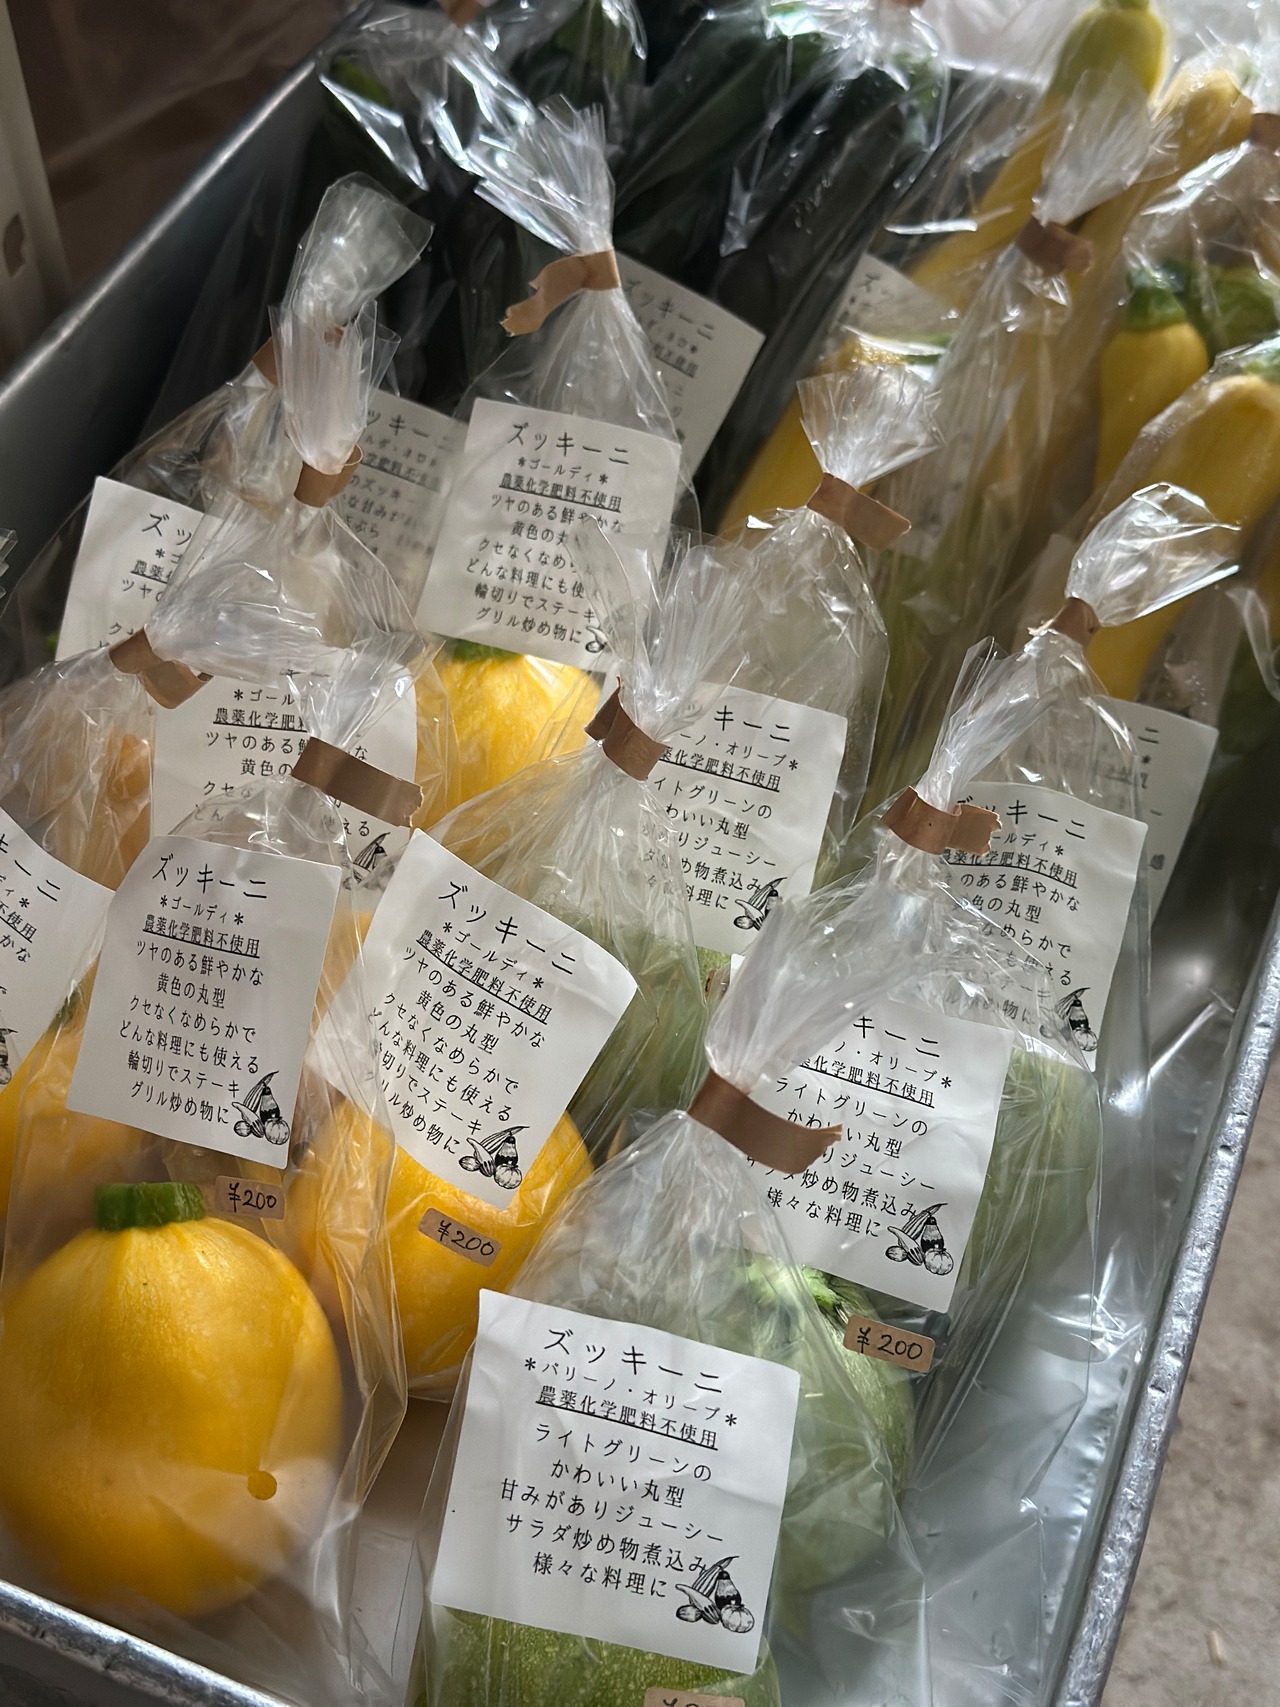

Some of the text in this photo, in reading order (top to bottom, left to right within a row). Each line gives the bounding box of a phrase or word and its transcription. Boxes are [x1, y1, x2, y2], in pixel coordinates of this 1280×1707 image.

[507, 422, 630, 465] ズッキーニ
[500, 473, 623, 512] 農薬化学肥料不使用
[475, 582, 597, 623] 輪切りでステーキ
[476, 606, 582, 643] グリル炒め物に
[152, 853, 267, 899] ズッキーニ
[143, 914, 260, 958] 農薬化学肥料不使用
[438, 881, 577, 975] ズッキーニ
[137, 940, 264, 986] ツヤのある鮮やかな
[416, 929, 553, 1025] 農薬化学肥料不使用
[156, 972, 227, 1009] 黄色の丸型
[402, 946, 547, 1049] ツヤのある鮮やかな
[130, 994, 256, 1044] クセなくなめらかで
[384, 992, 520, 1093] クセなくなめらかで
[416, 990, 500, 1055] 黄色の丸型
[853, 1016, 940, 1058] キーニ
[119, 1019, 259, 1075] どんな料理にも使える
[368, 1006, 512, 1122] どんな料理にも使える
[127, 1049, 240, 1099] 輪切りでステーキ
[131, 1080, 229, 1126] グリル炒め物に
[776, 1077, 928, 1136] ライトグリーンの
[822, 1147, 935, 1191] りジューシー
[228, 1182, 277, 1213] ¥200
[767, 1186, 879, 1237] 様々な料理に
[438, 1219, 494, 1256] ¥200
[544, 1328, 722, 1393] ズッキーニ
[857, 1327, 922, 1360] ¥200
[536, 1384, 718, 1450] 農薬化学肥料不使用
[536, 1423, 712, 1482] ライトグリーンの
[551, 1458, 685, 1509] かわいい丸型
[500, 1477, 724, 1543] 甘みがありジューシー
[506, 1513, 708, 1573] サラダ炒め物煮込み
[532, 1550, 667, 1598] 様々な料理に
